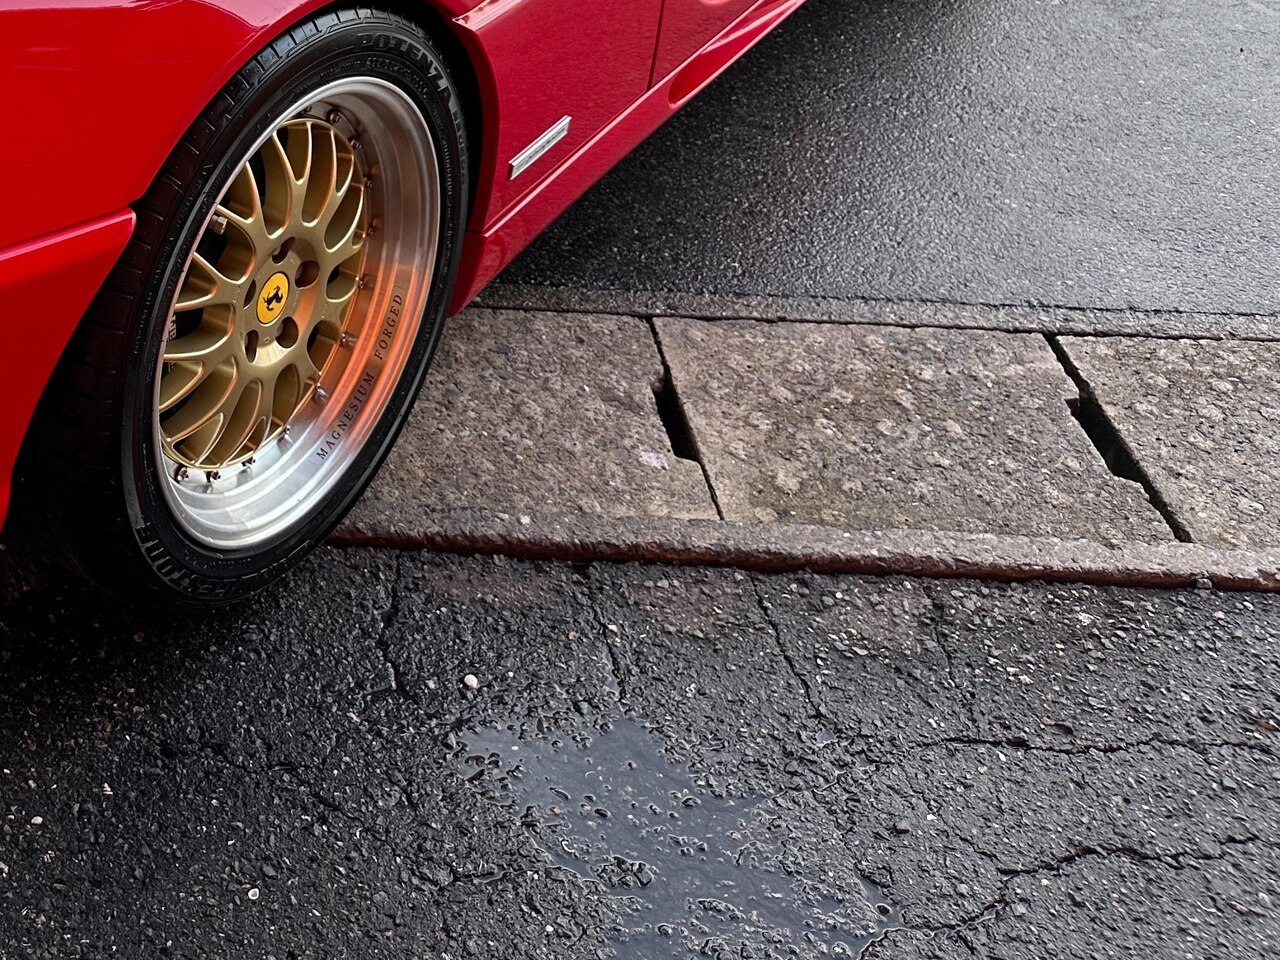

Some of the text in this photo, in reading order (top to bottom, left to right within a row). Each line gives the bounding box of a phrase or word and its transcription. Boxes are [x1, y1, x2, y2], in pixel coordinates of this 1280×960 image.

[353, 32, 454, 104] POTENZA
[315, 294, 403, 461] MAGNESIUM FORGED
